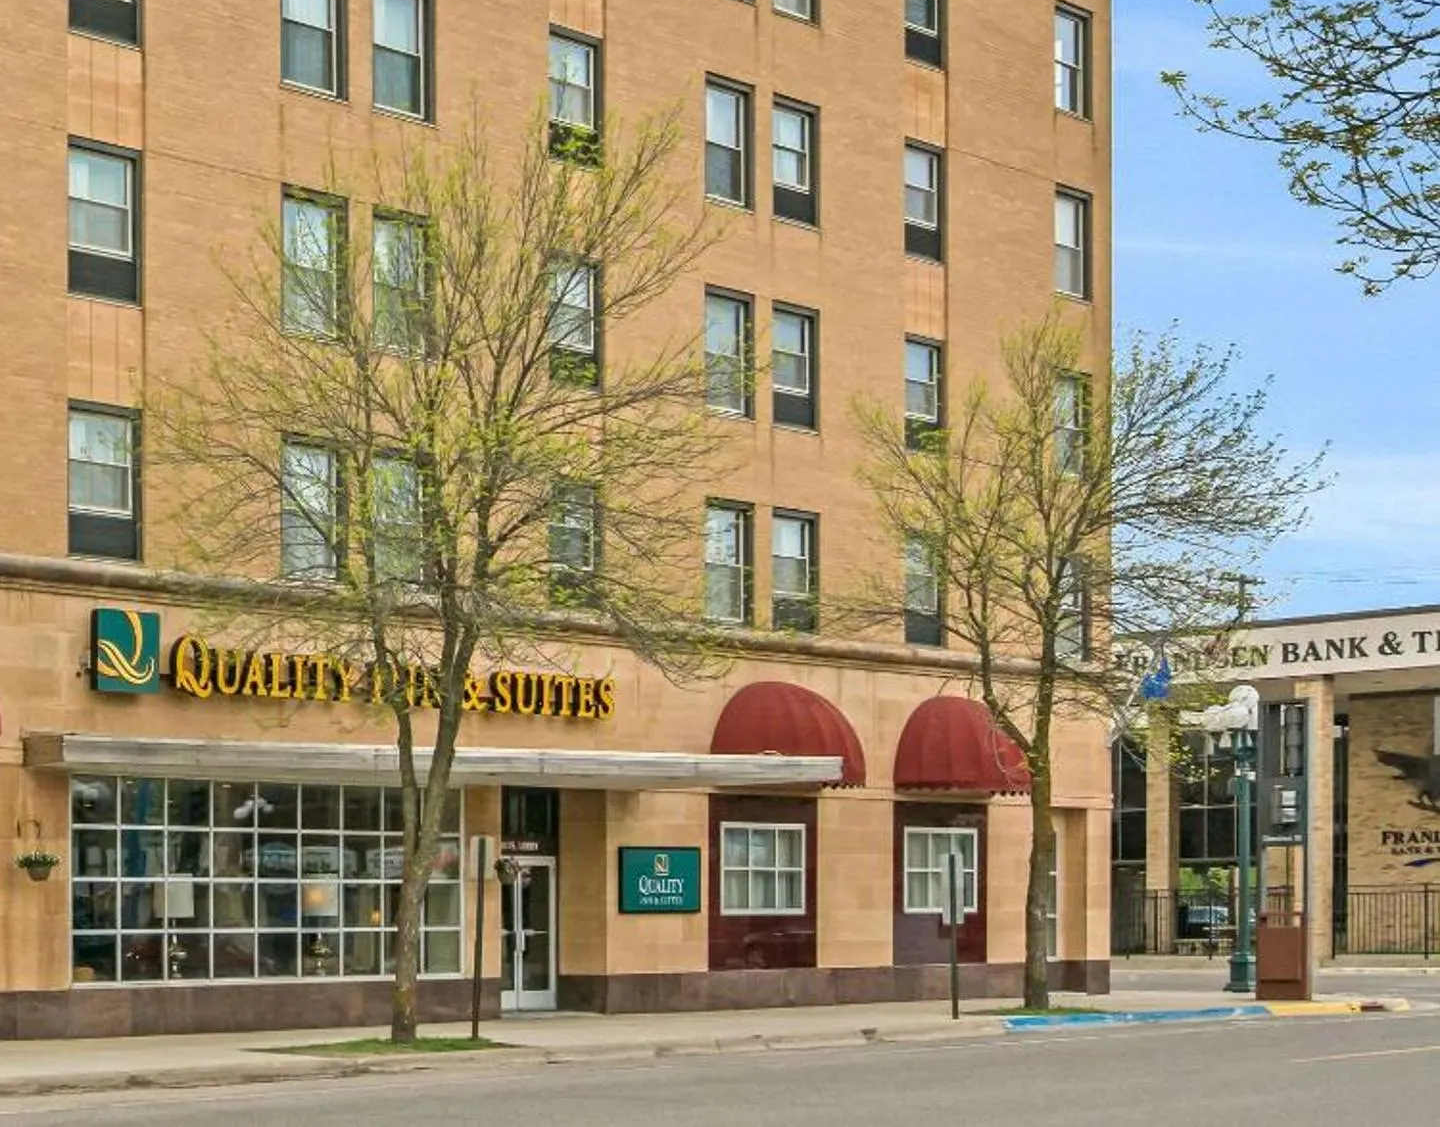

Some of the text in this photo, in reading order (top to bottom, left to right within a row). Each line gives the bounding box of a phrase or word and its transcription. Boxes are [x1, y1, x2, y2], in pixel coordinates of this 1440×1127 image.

[1281, 636, 1369, 664] BANK
[1377, 630, 1405, 656] &
[1411, 630, 1440, 653] T
[171, 633, 353, 703] QUALITY
[461, 669, 488, 712] &
[493, 670, 617, 719] SUITES
[638, 875, 684, 895] QUALITY
